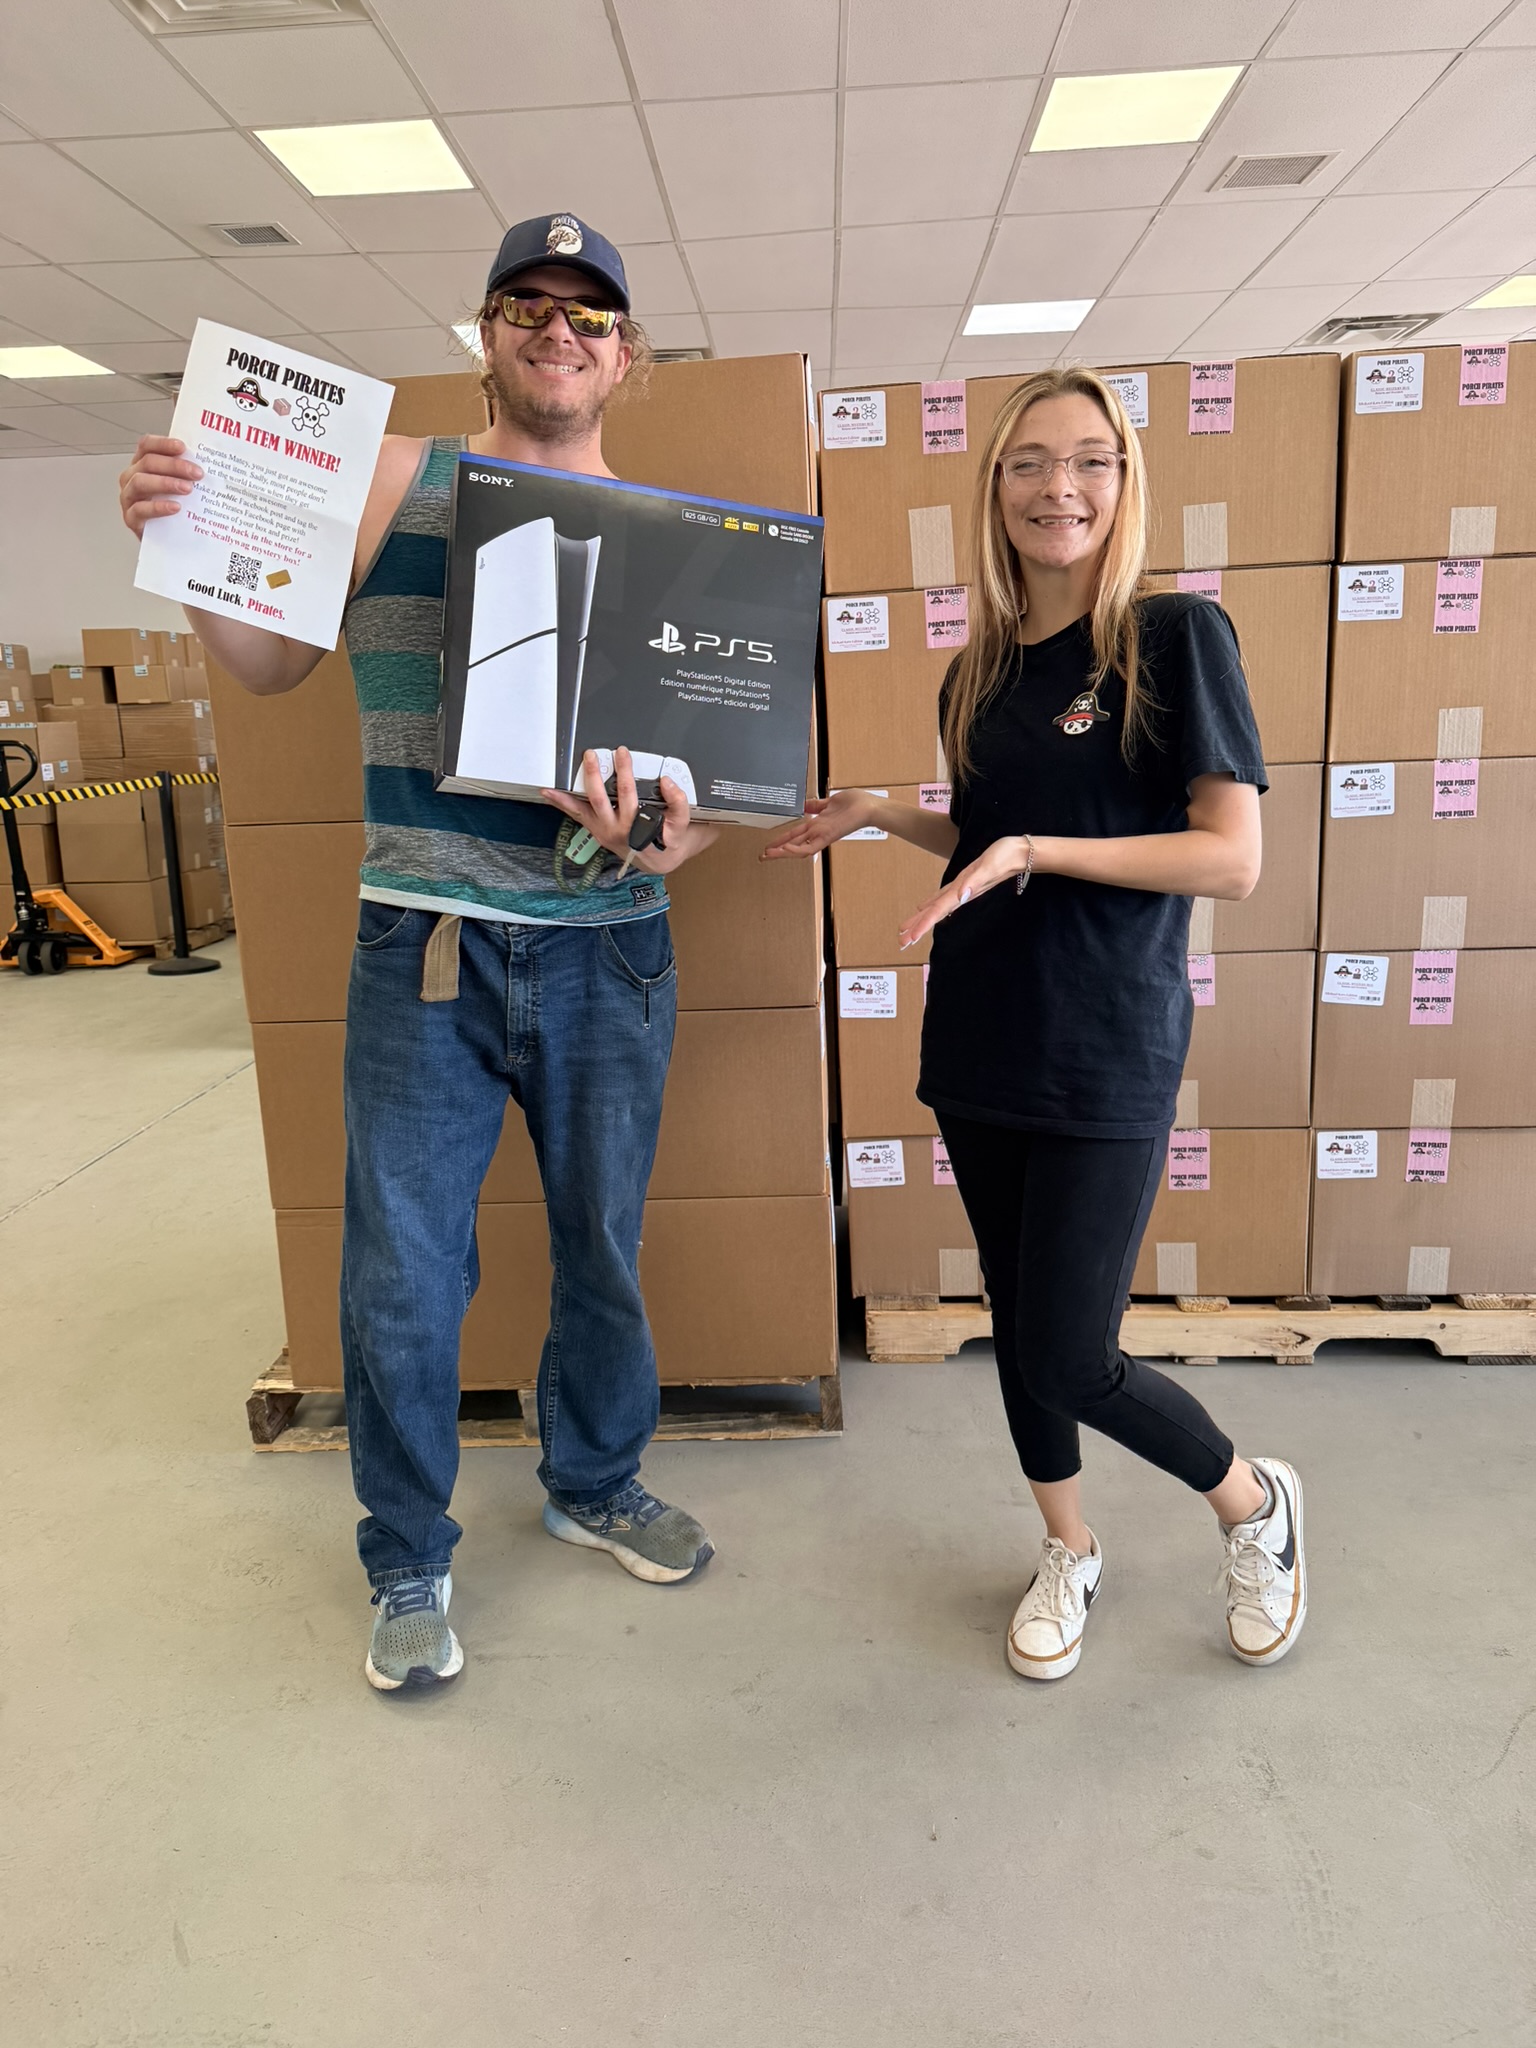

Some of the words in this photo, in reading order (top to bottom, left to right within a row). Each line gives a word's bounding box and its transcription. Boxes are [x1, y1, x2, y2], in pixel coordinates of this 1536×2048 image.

[226, 348, 280, 382] PORCH
[281, 367, 345, 405] PIRATES
[942, 395, 963, 403] PIRATES
[200, 409, 241, 438] ULTRA
[245, 425, 280, 451] ITEM
[284, 438, 341, 472] WINNER!
[196, 453, 231, 470] high-ticket
[233, 466, 247, 476] item.
[250, 472, 268, 484] Sadly,
[270, 480, 285, 490] most
[286, 486, 307, 497] people
[308, 493, 325, 504] don't
[198, 443, 227, 459] Congrats
[228, 454, 250, 468] Matey,
[252, 464, 264, 472] you
[264, 467, 277, 476] just
[298, 481, 327, 494] awesome
[208, 467, 216, 475] let
[218, 471, 228, 479] the
[229, 476, 248, 486] world
[248, 482, 265, 492] know
[267, 488, 283, 499] when
[285, 495, 298, 505] they
[469, 472, 514, 487] SONY
[192, 482, 210, 493] Make
[216, 492, 238, 503] public
[239, 498, 268, 513] Facebook
[270, 509, 284, 518] post
[284, 515, 296, 523] and
[297, 519, 307, 528] tag
[308, 522, 318, 530] the
[226, 484, 258, 500] something
[259, 496, 287, 509] awesome
[201, 495, 220, 507] Porch
[222, 502, 243, 515] Pirates
[244, 509, 274, 525] Facebook
[276, 522, 291, 531] page
[292, 527, 306, 536] with
[203, 508, 229, 520] pictures
[239, 520, 254, 529] your
[256, 524, 266, 532] box
[268, 529, 280, 537] and
[281, 533, 299, 543] prize!
[697, 514, 717, 523] GB/Go
[187, 511, 206, 523] Then
[208, 520, 229, 530] come
[231, 526, 249, 538] back
[251, 532, 259, 540] in
[261, 536, 272, 545] the
[274, 542, 293, 552] store
[295, 548, 306, 557] for
[194, 525, 209, 535] free
[211, 530, 250, 550] Scallywag
[252, 545, 281, 560] mystery
[284, 554, 300, 566] box!
[188, 578, 215, 597] Good
[217, 588, 244, 608] Luck,
[247, 598, 285, 620] Pirates.
[694, 632, 773, 662] PS5
[661, 678, 684, 688] Édition
[687, 683, 723, 694] numérique
[724, 677, 745, 686] Digital
[747, 680, 770, 689] Edition
[724, 699, 747, 708] edición
[749, 702, 769, 711] digital
[557, 818, 574, 850] HEALT
[583, 856, 605, 887] HANDS
